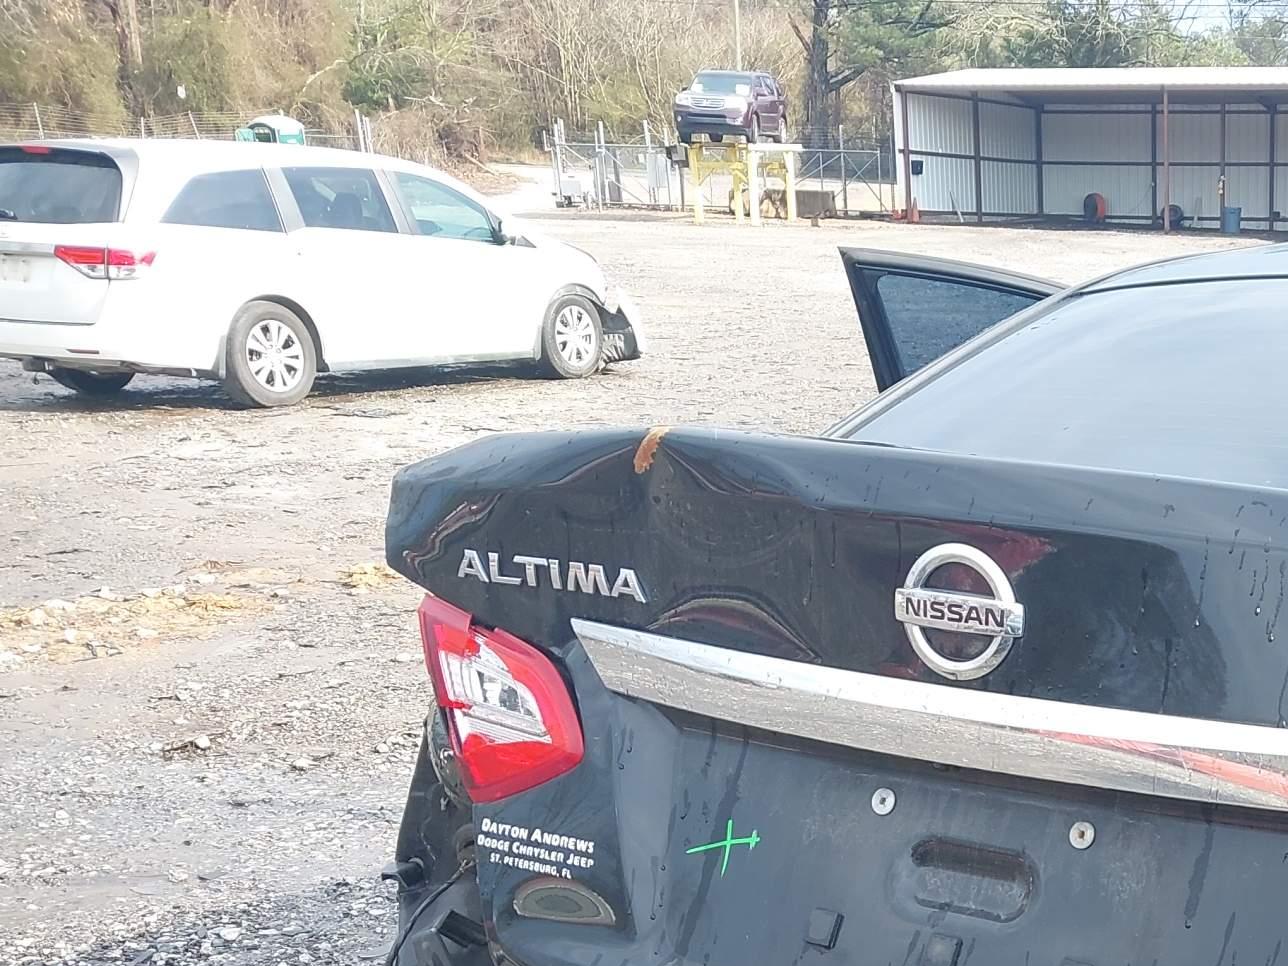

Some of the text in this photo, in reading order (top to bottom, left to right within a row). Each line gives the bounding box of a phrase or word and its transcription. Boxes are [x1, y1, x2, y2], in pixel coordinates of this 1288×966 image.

[457, 549, 646, 603] ALTIMA
[905, 597, 1005, 628] NISSAN
[477, 834, 595, 868] DODGE CHRYSLER JEEP
[481, 817, 595, 854] DAYTON ANDREWS
[490, 852, 502, 864] ST.
[561, 868, 572, 880] FL
